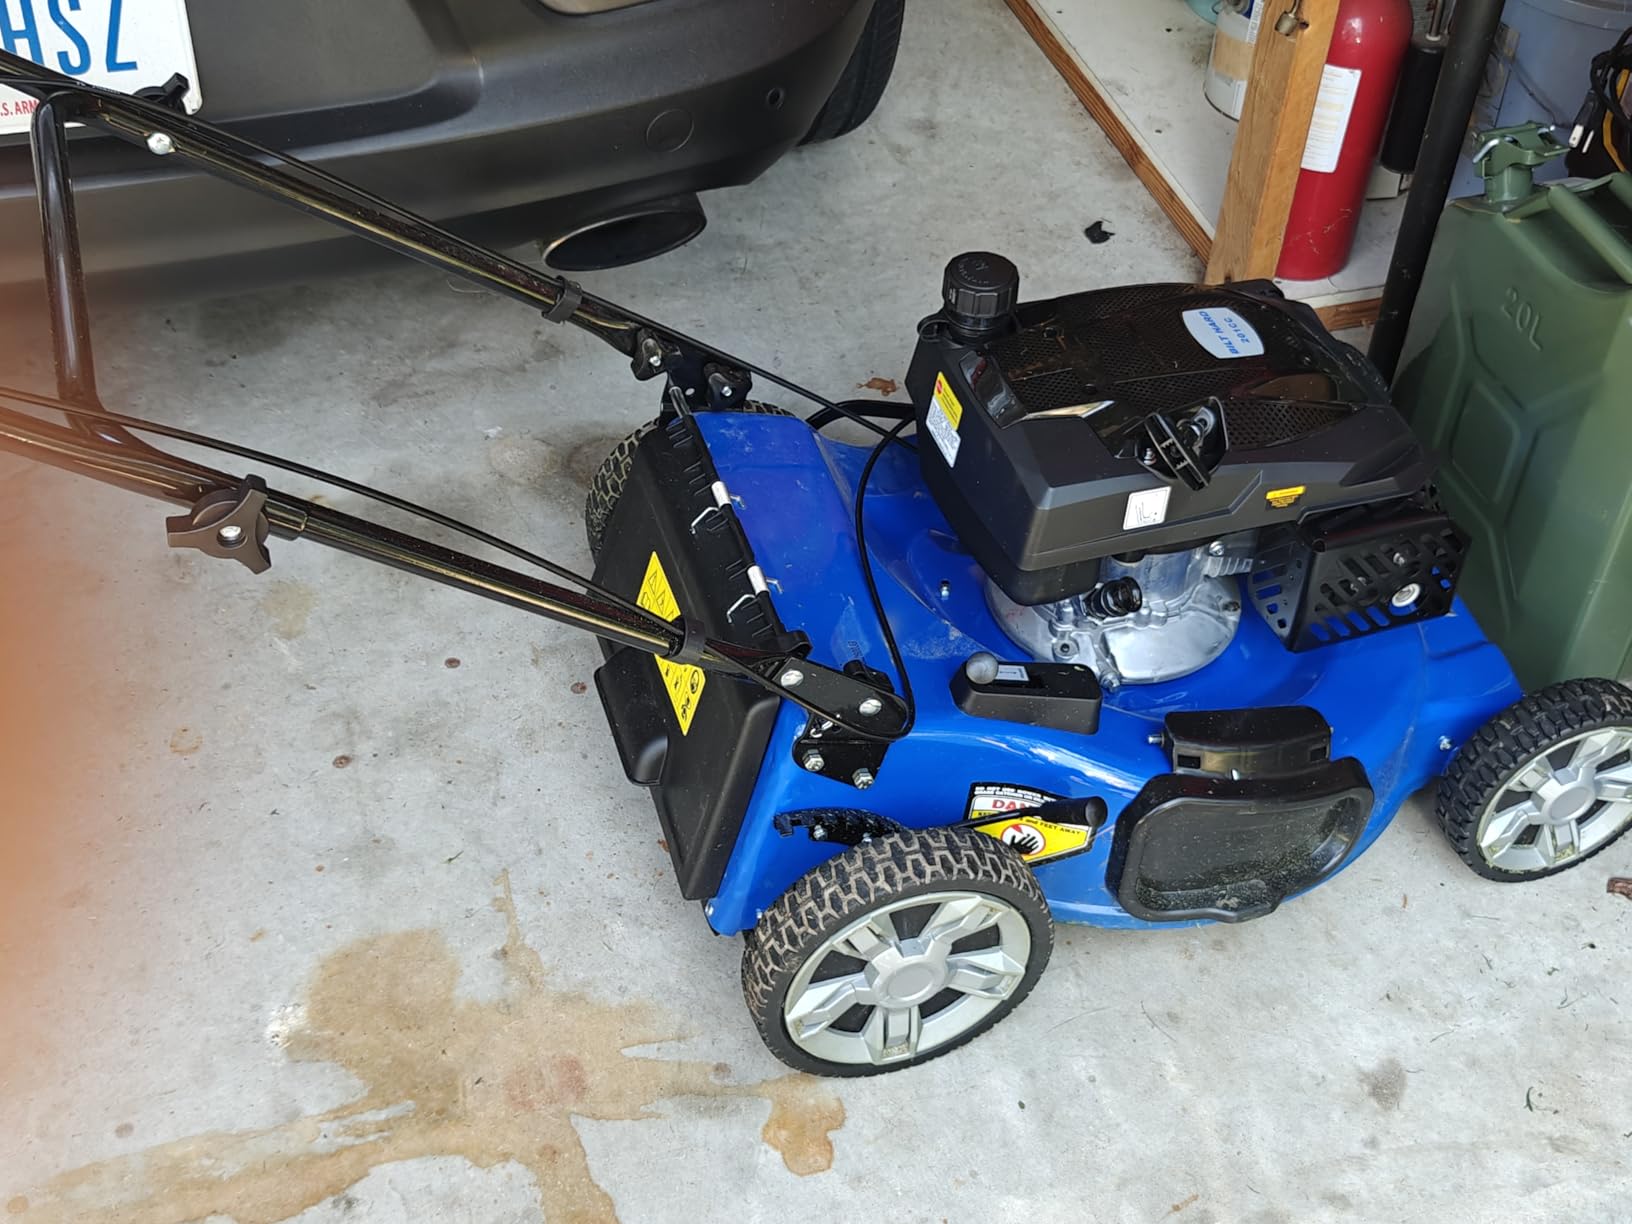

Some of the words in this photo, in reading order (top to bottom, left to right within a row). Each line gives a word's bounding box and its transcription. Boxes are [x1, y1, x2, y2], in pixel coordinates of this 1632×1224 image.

[15, 99, 38, 115] ARM
[1199, 311, 1224, 334] HARD
[1223, 317, 1250, 343] 201CC
[1501, 287, 1542, 350] 20L
[1218, 335, 1240, 354] BILT
